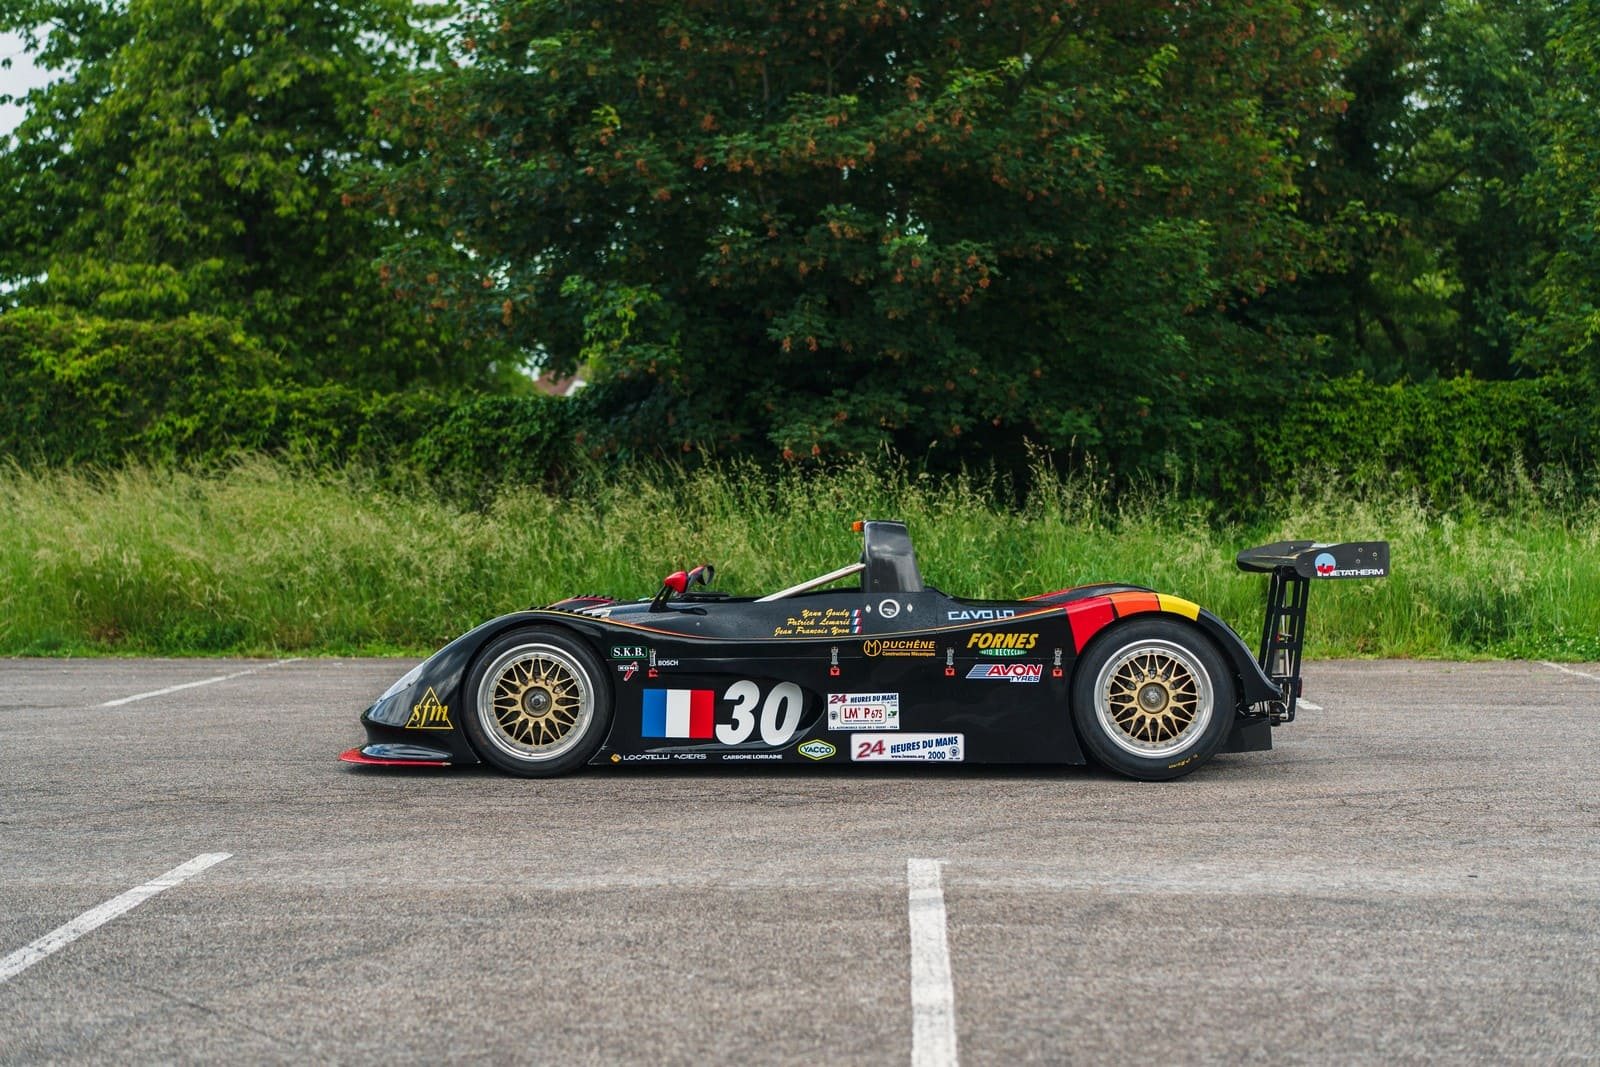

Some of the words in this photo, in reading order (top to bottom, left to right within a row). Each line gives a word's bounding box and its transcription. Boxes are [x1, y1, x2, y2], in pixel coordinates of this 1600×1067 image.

[801, 608, 822, 619] Yann
[786, 617, 816, 627] Patrick
[774, 626, 793, 637] Jean
[831, 626, 850, 636] Yvon
[882, 639, 936, 649] DUCHÊNE
[966, 632, 1040, 649] FORNES
[613, 647, 645, 657] S.K.B.
[987, 664, 1042, 676] AVON
[829, 694, 848, 704] 24
[850, 695, 872, 703] HEURES
[410, 697, 449, 727] sfm
[715, 680, 804, 746] 30
[857, 739, 886, 759] 24
[890, 741, 921, 754] HEURES
[922, 739, 934, 749] DU
[935, 736, 958, 748] MANS
[928, 751, 946, 760] 2000
